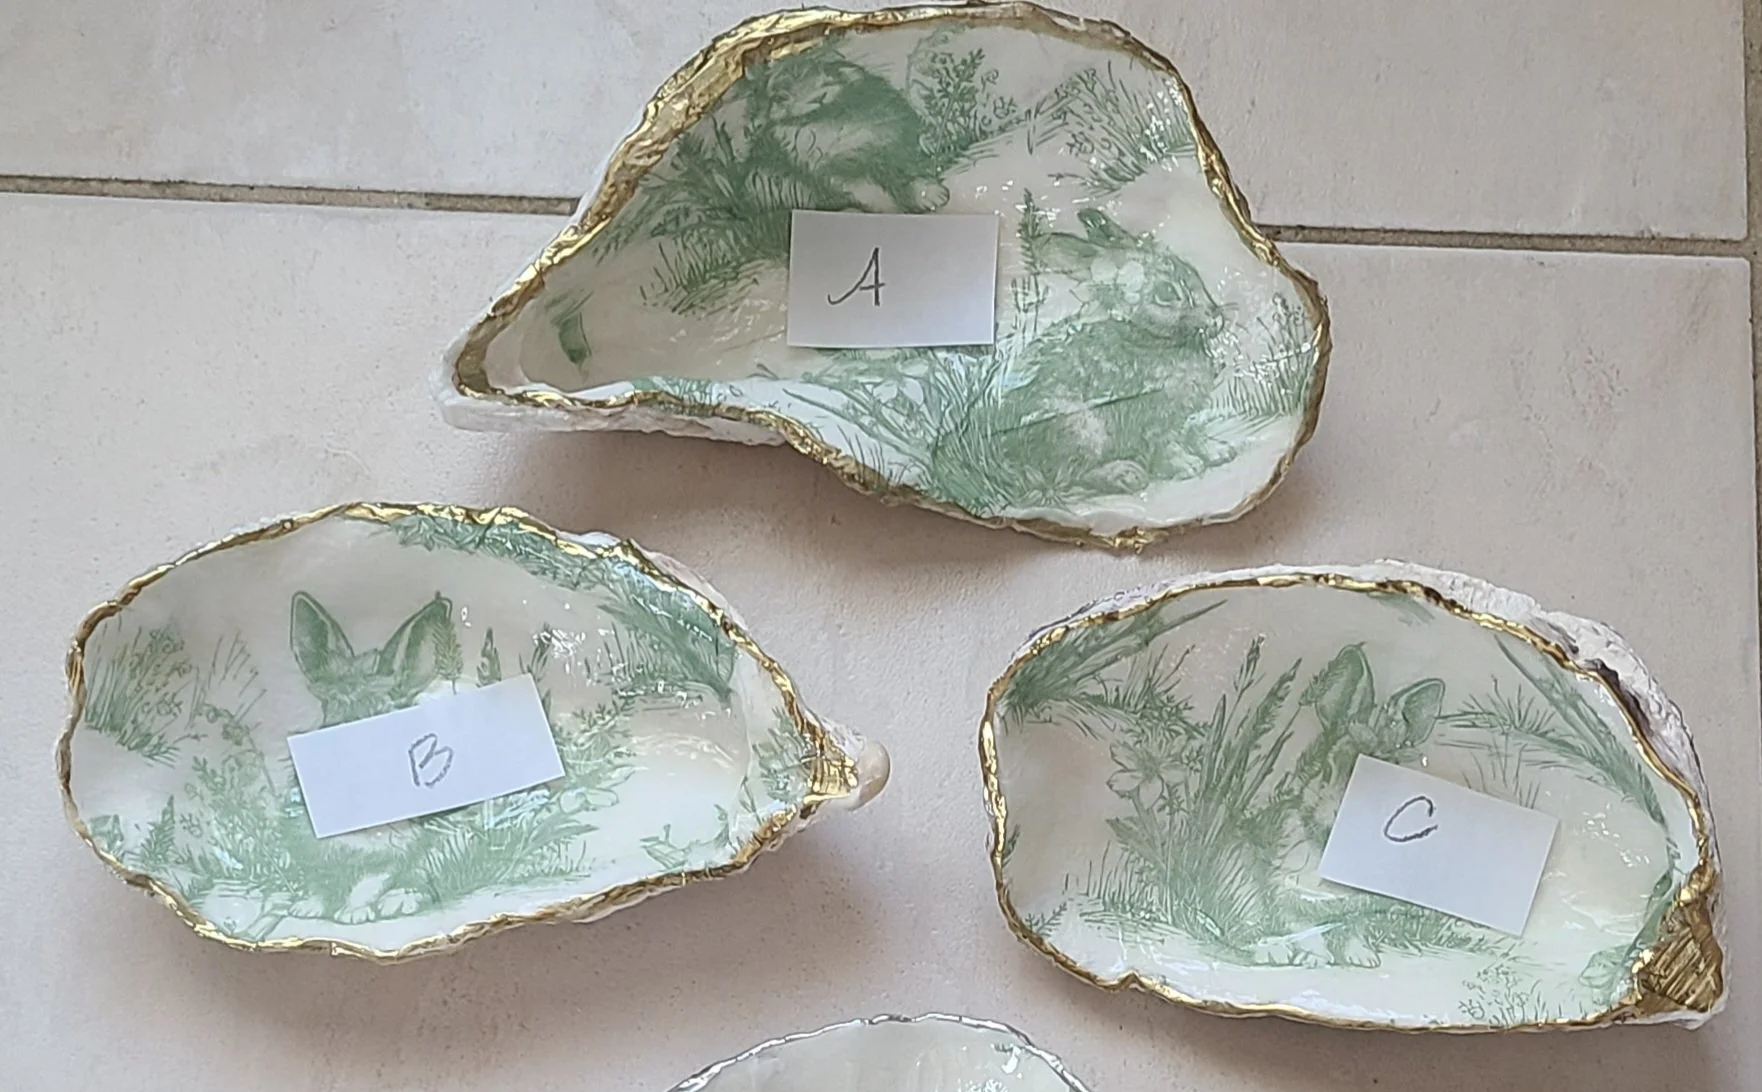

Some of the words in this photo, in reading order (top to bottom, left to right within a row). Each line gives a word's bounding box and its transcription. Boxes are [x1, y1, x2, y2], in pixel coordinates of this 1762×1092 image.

[827, 247, 886, 307] A
[408, 733, 454, 788] B
[1383, 796, 1439, 843] C
